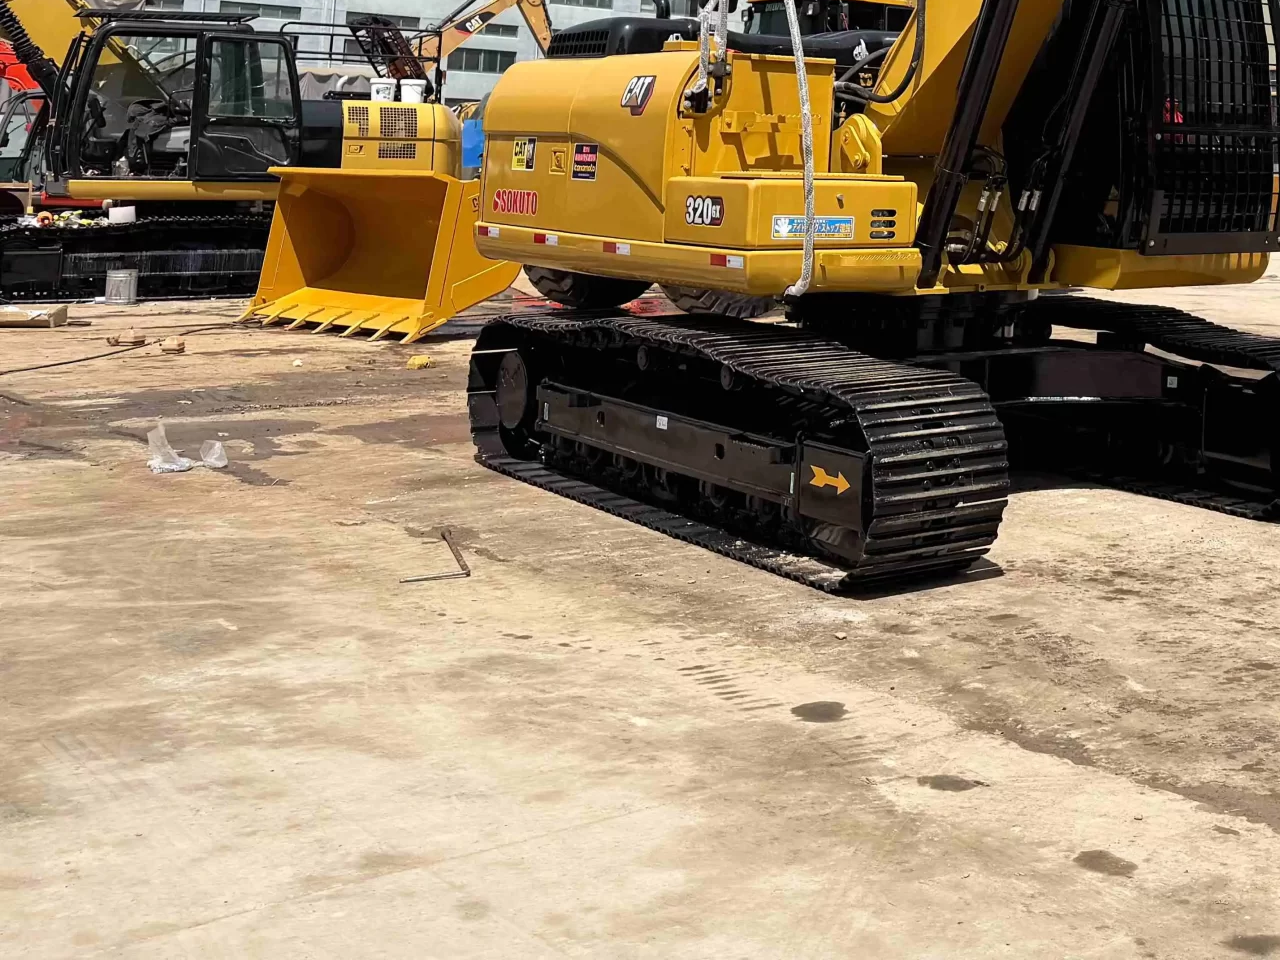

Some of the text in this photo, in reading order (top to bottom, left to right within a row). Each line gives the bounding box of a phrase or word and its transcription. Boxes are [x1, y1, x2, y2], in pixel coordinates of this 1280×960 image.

[465, 15, 483, 32] CAT
[621, 76, 654, 106] CAT
[500, 190, 538, 216] SOKUTO
[685, 196, 721, 225] 320 GX
